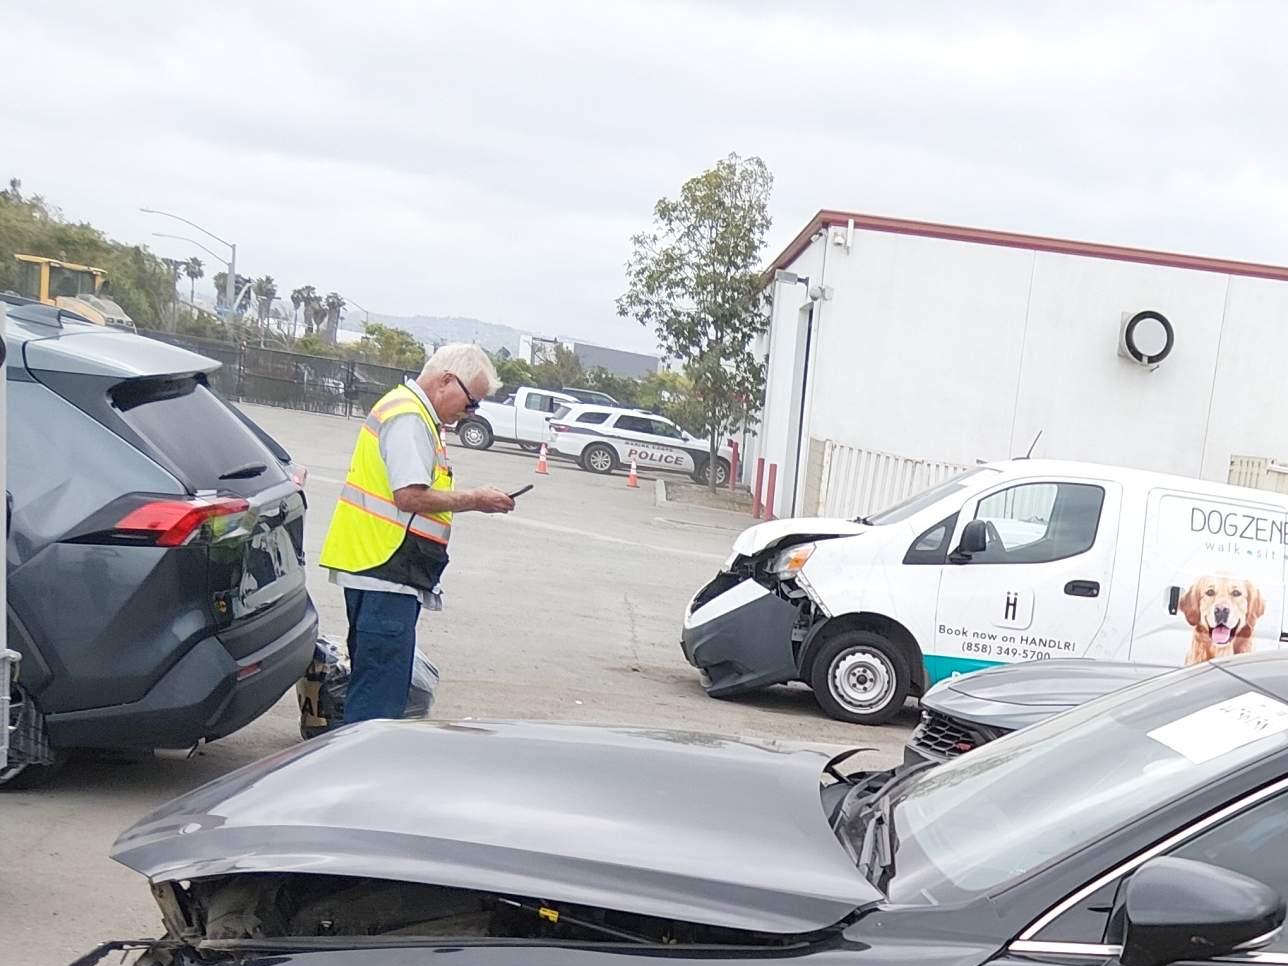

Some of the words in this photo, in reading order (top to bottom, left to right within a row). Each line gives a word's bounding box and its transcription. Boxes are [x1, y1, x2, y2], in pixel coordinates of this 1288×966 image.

[628, 448, 684, 465] POLICE
[938, 625, 968, 637] Book
[972, 631, 997, 641] now
[1001, 635, 1016, 643] on
[1020, 636, 1076, 652] HANDLR!
[961, 641, 992, 655] (858)
[996, 646, 1051, 660] 349-5700
